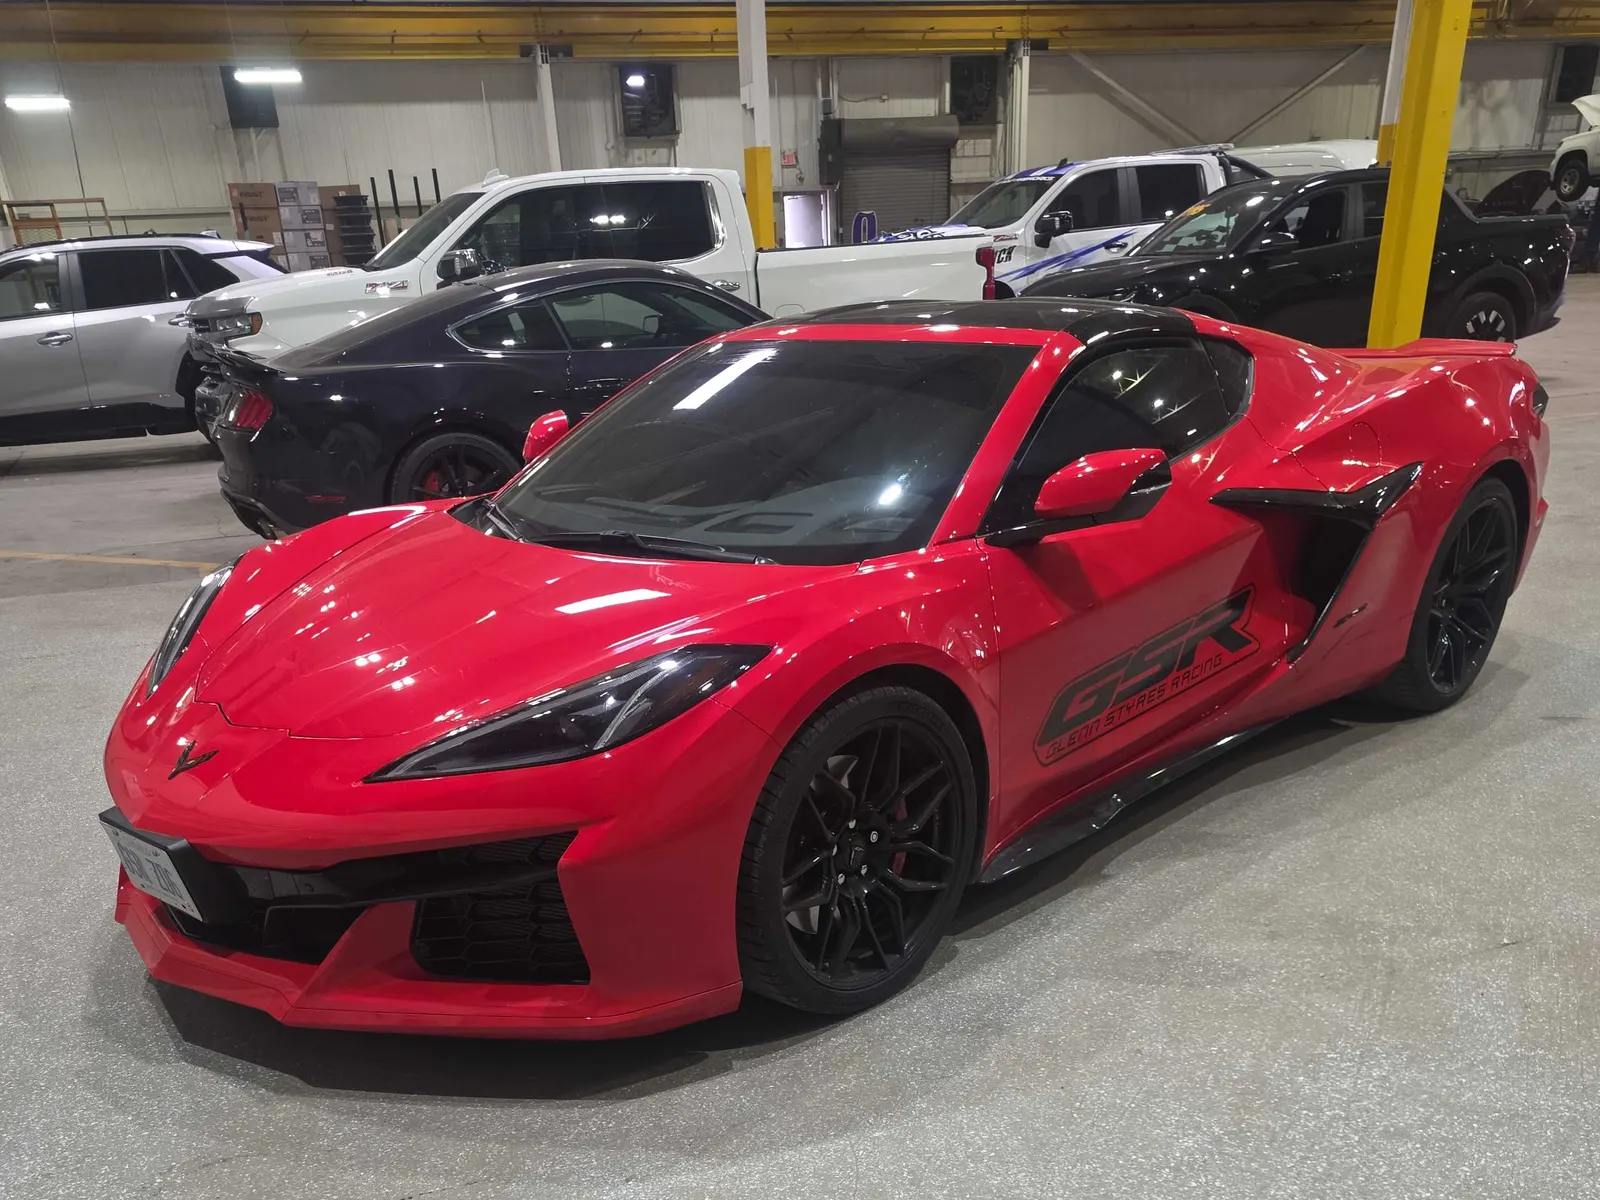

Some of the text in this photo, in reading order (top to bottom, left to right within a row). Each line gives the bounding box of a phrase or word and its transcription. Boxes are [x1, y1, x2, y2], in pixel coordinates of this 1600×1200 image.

[1039, 589, 1253, 746] GSR
[1046, 652, 1223, 760] GLENN STYRES RACING
